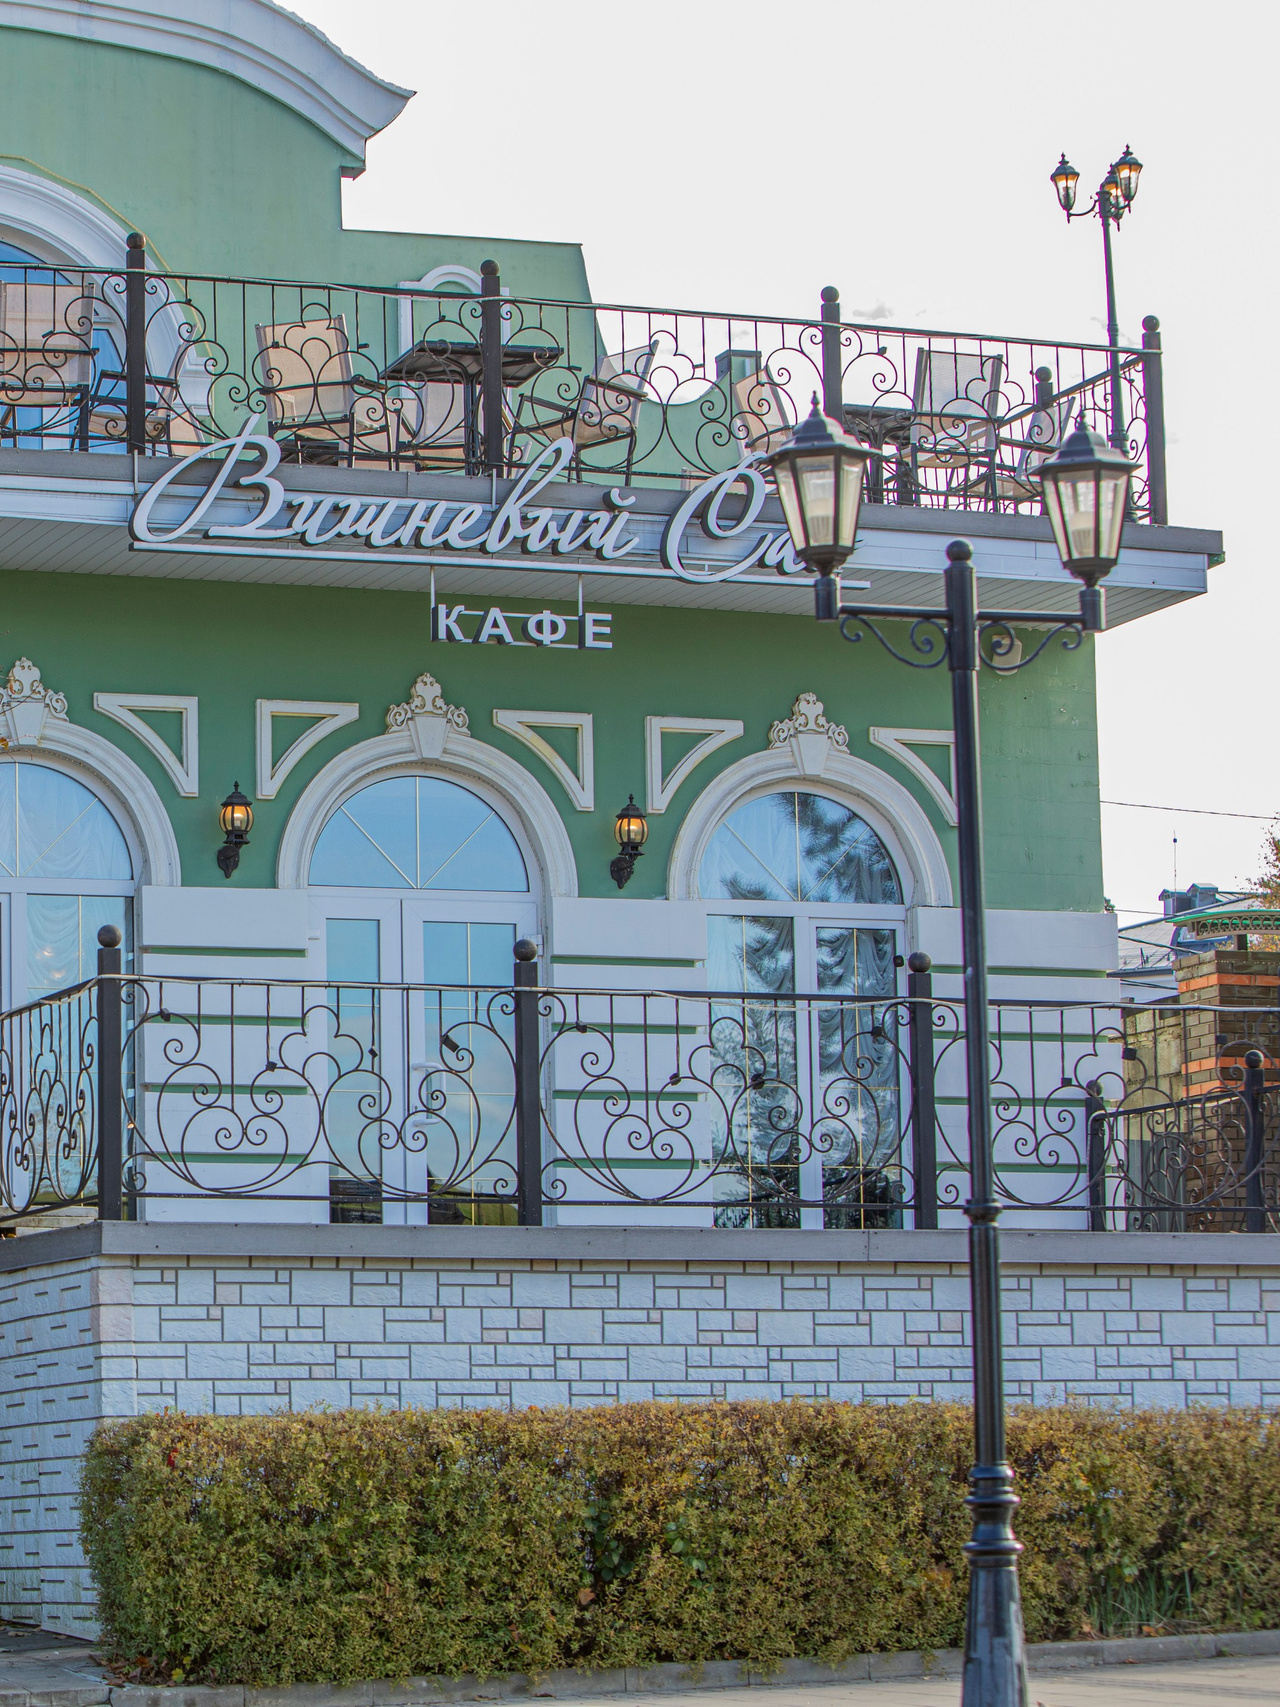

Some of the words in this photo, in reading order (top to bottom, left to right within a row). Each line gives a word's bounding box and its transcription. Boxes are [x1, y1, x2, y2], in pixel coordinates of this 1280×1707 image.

[130, 413, 640, 560] Вишневый
[662, 451, 865, 584] Са
[434, 604, 614, 650] КАФЕ
